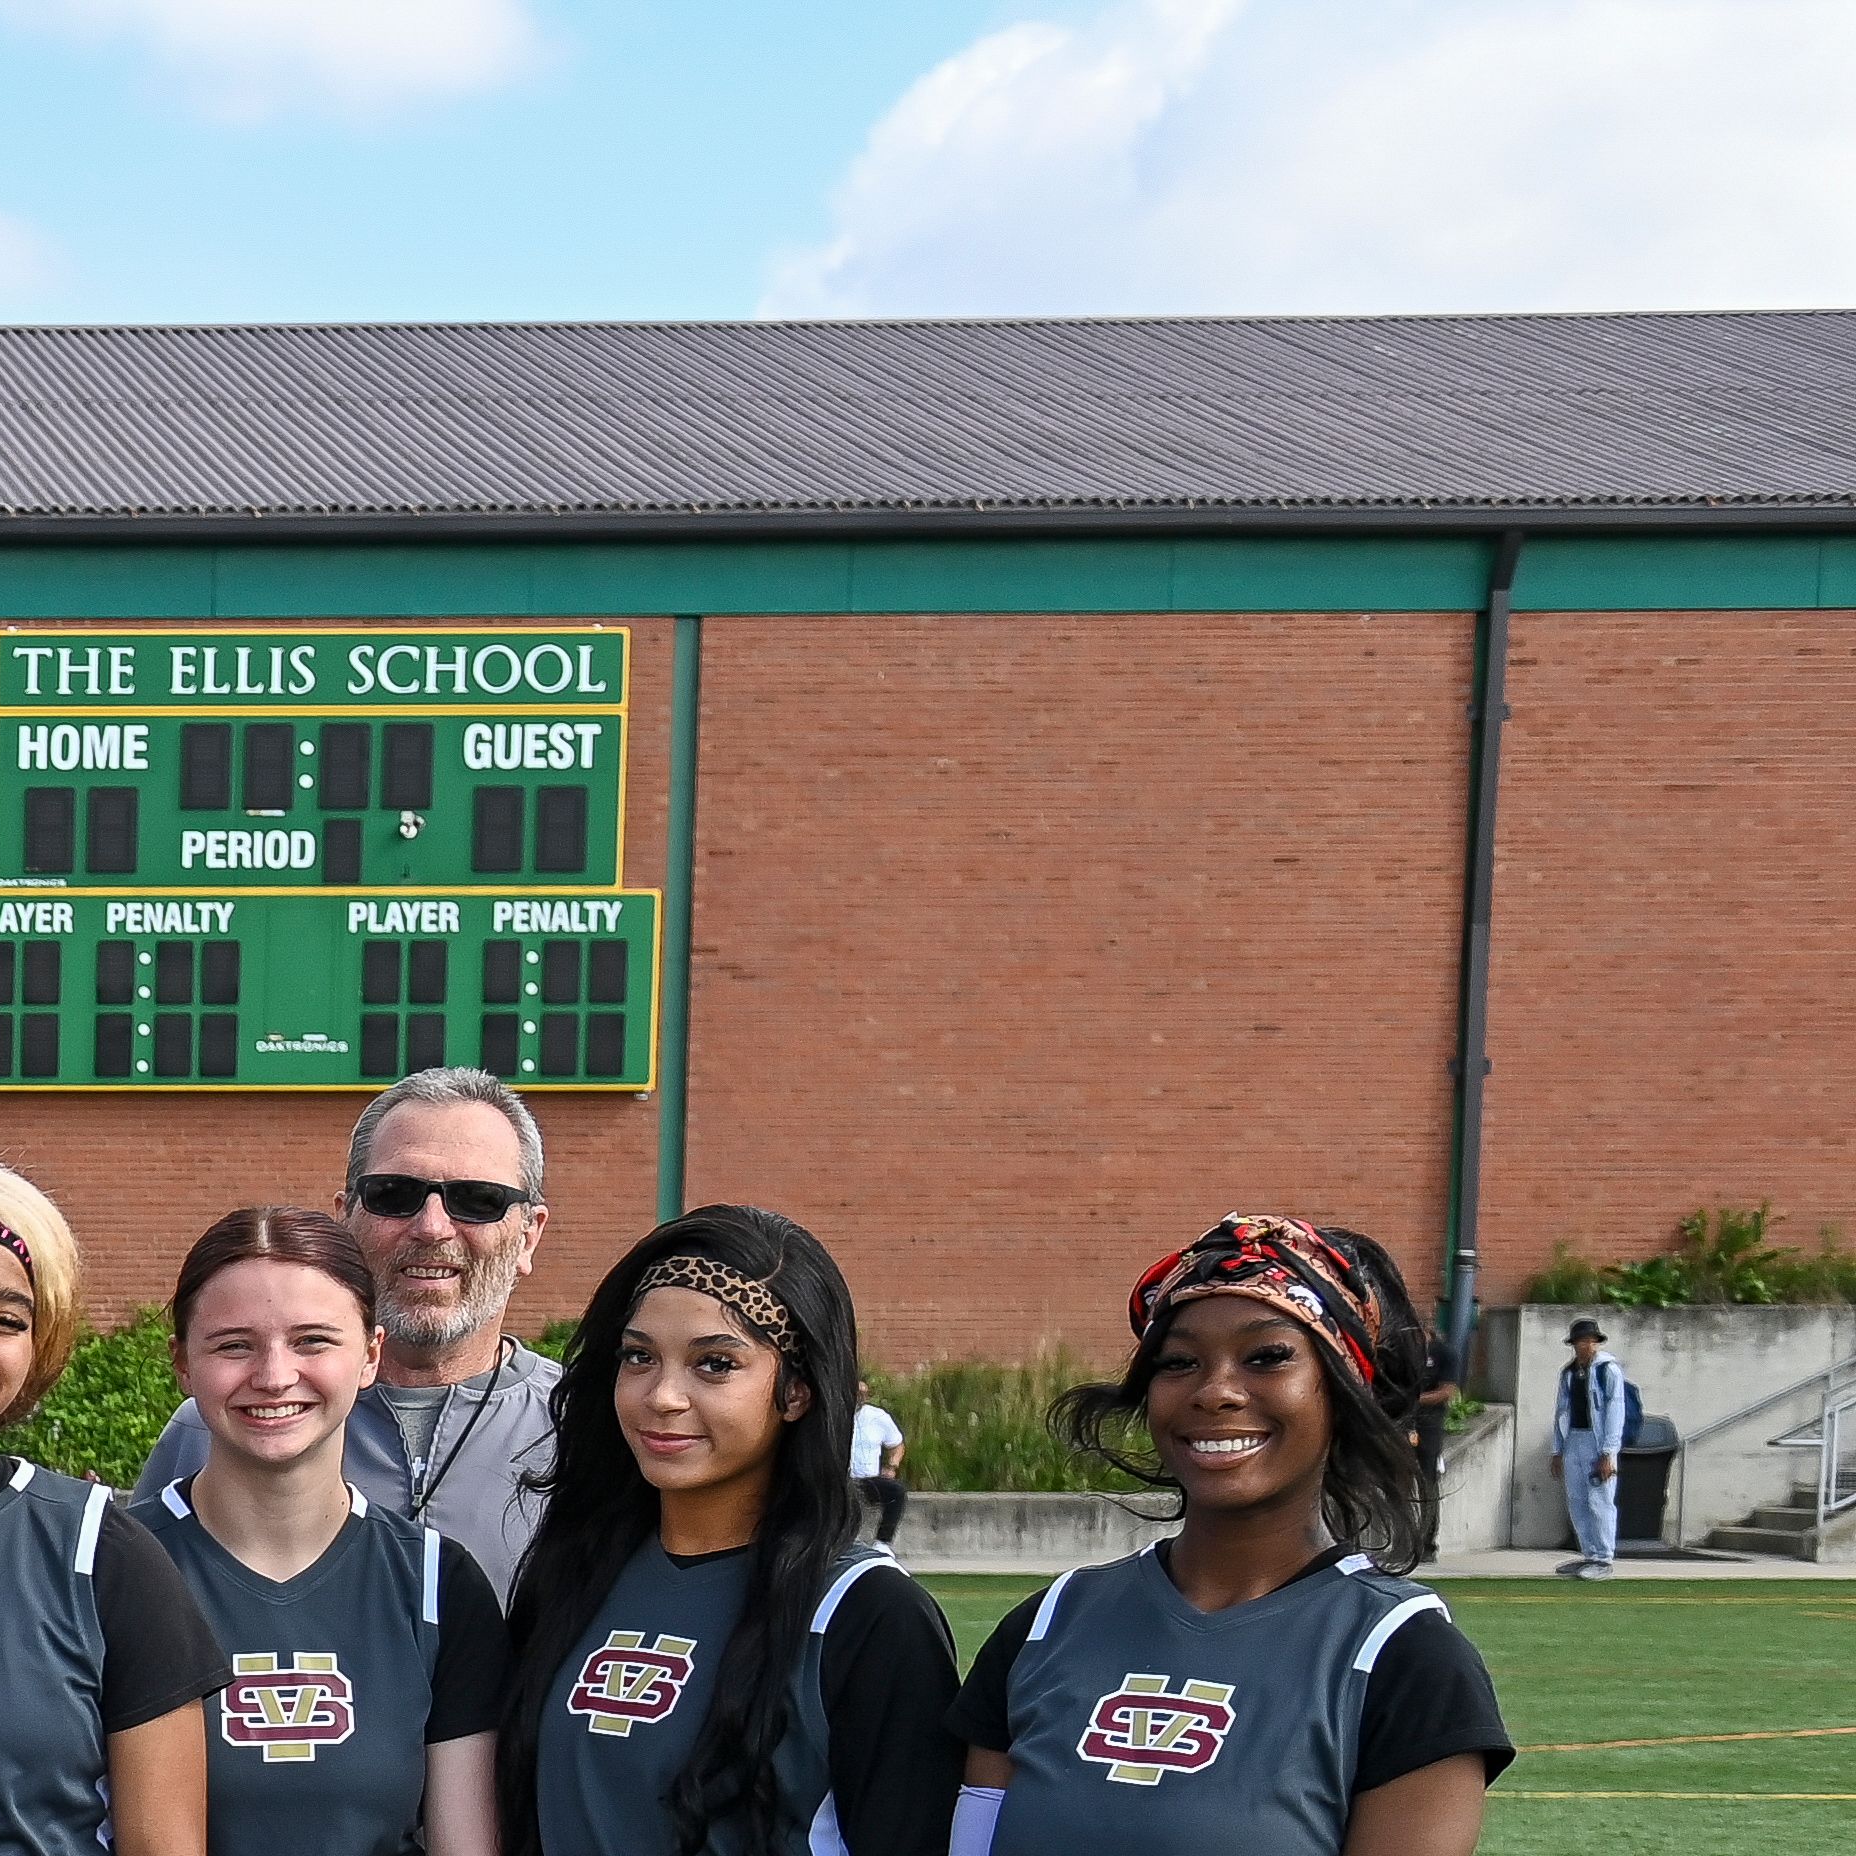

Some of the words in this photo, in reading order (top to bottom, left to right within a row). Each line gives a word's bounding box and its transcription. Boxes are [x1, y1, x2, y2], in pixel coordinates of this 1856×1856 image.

[13, 646, 136, 695] THE
[170, 645, 317, 695] ELLIS
[347, 643, 608, 695] SCHOOL
[18, 724, 150, 772] HOME
[463, 722, 603, 771] GUEST
[181, 830, 317, 870] PERIOD
[106, 901, 235, 935] PENALTY
[348, 901, 460, 934] PLAYER
[493, 900, 623, 933] PENALTY
